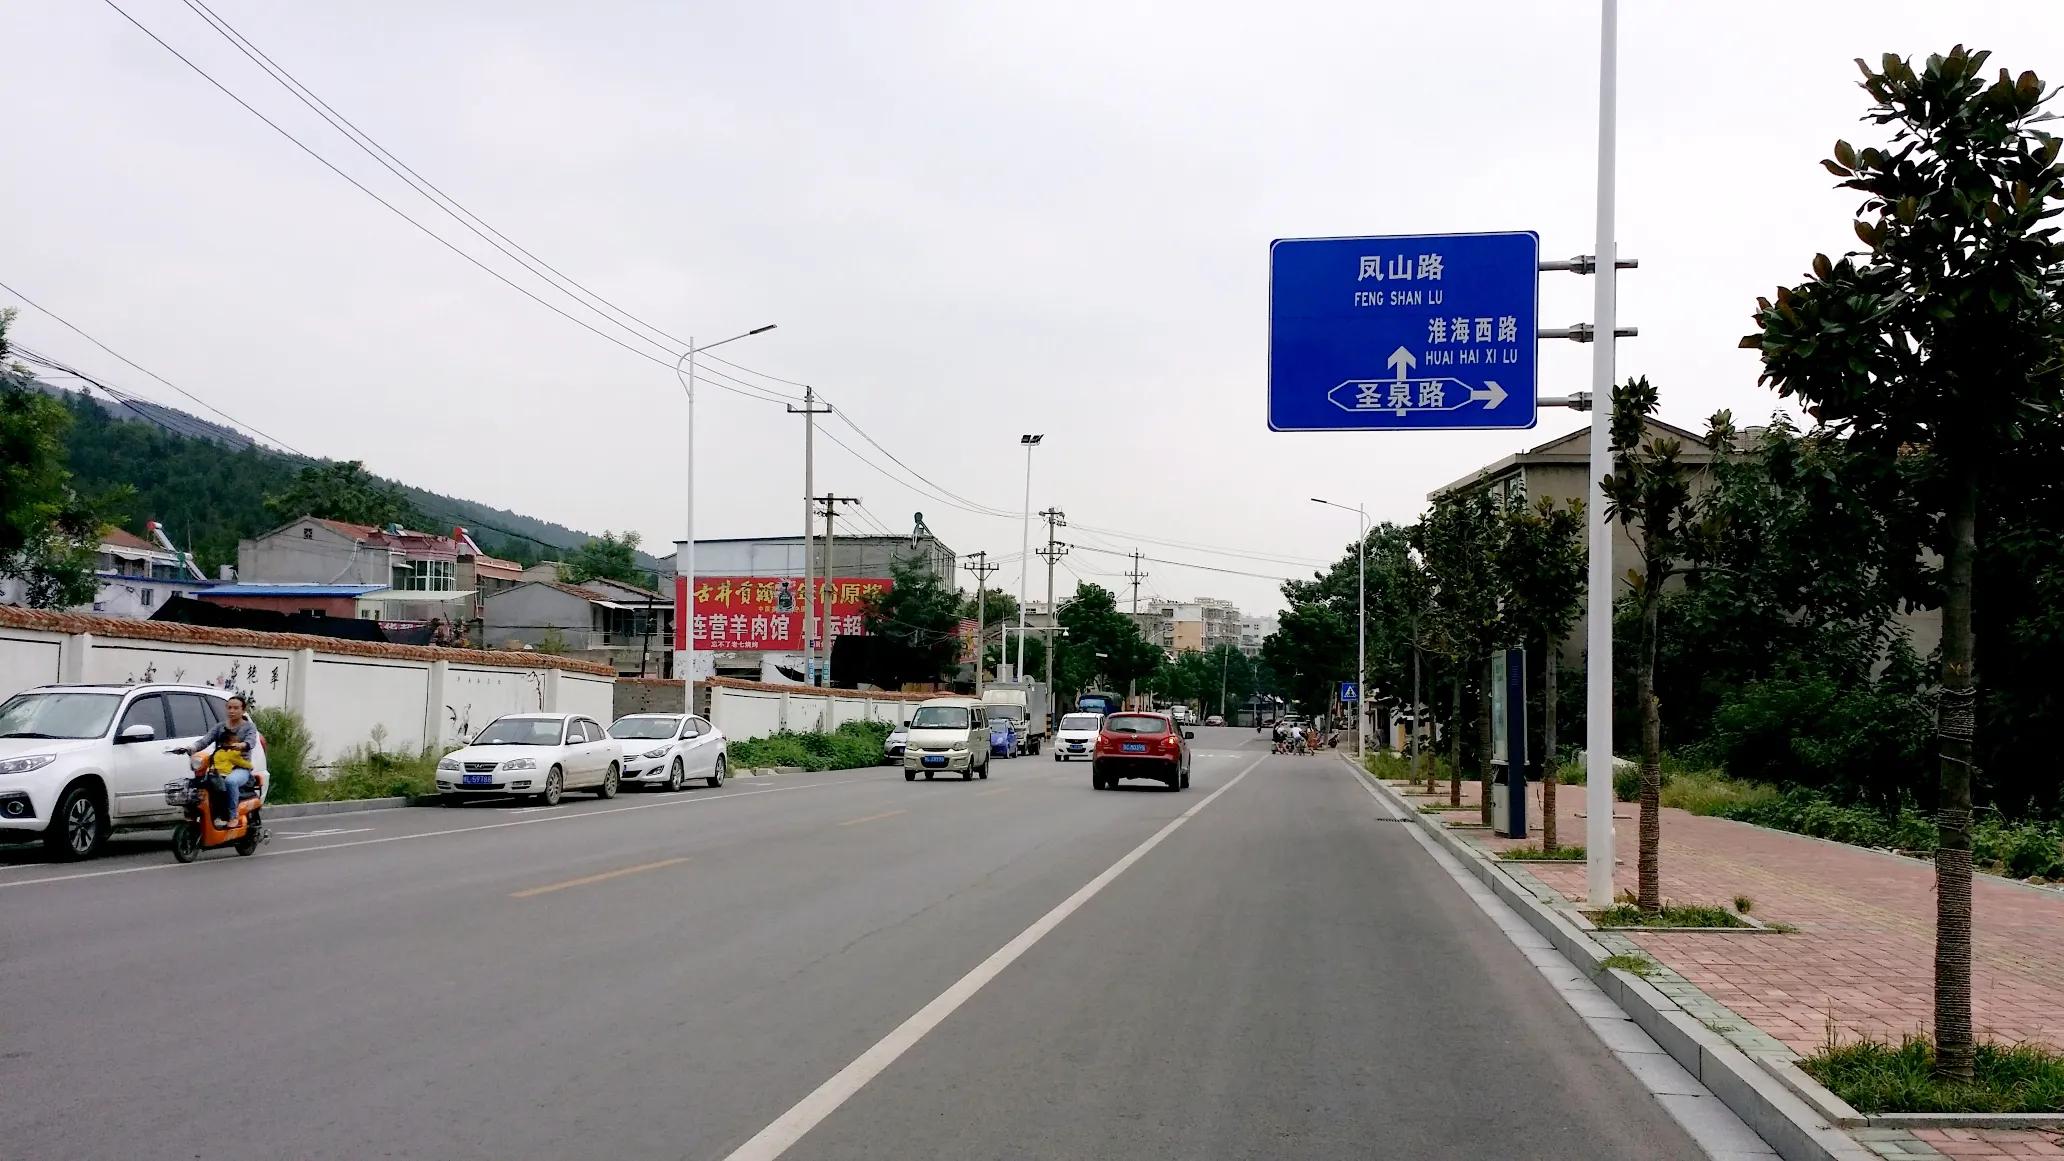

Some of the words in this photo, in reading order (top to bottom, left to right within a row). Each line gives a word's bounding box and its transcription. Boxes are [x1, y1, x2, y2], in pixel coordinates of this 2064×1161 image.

[1357, 253, 1444, 282] 凤山路
[1354, 291, 1384, 306] FENG
[1390, 290, 1422, 306] SHAN
[1428, 290, 1443, 305] LU
[1428, 315, 1518, 344] 淮海西路
[1425, 350, 1454, 365] HUAI
[1459, 349, 1480, 364] HAI
[1485, 349, 1497, 364] XI
[1502, 348, 1518, 364] LU
[1355, 381, 1446, 409] 圣泉路
